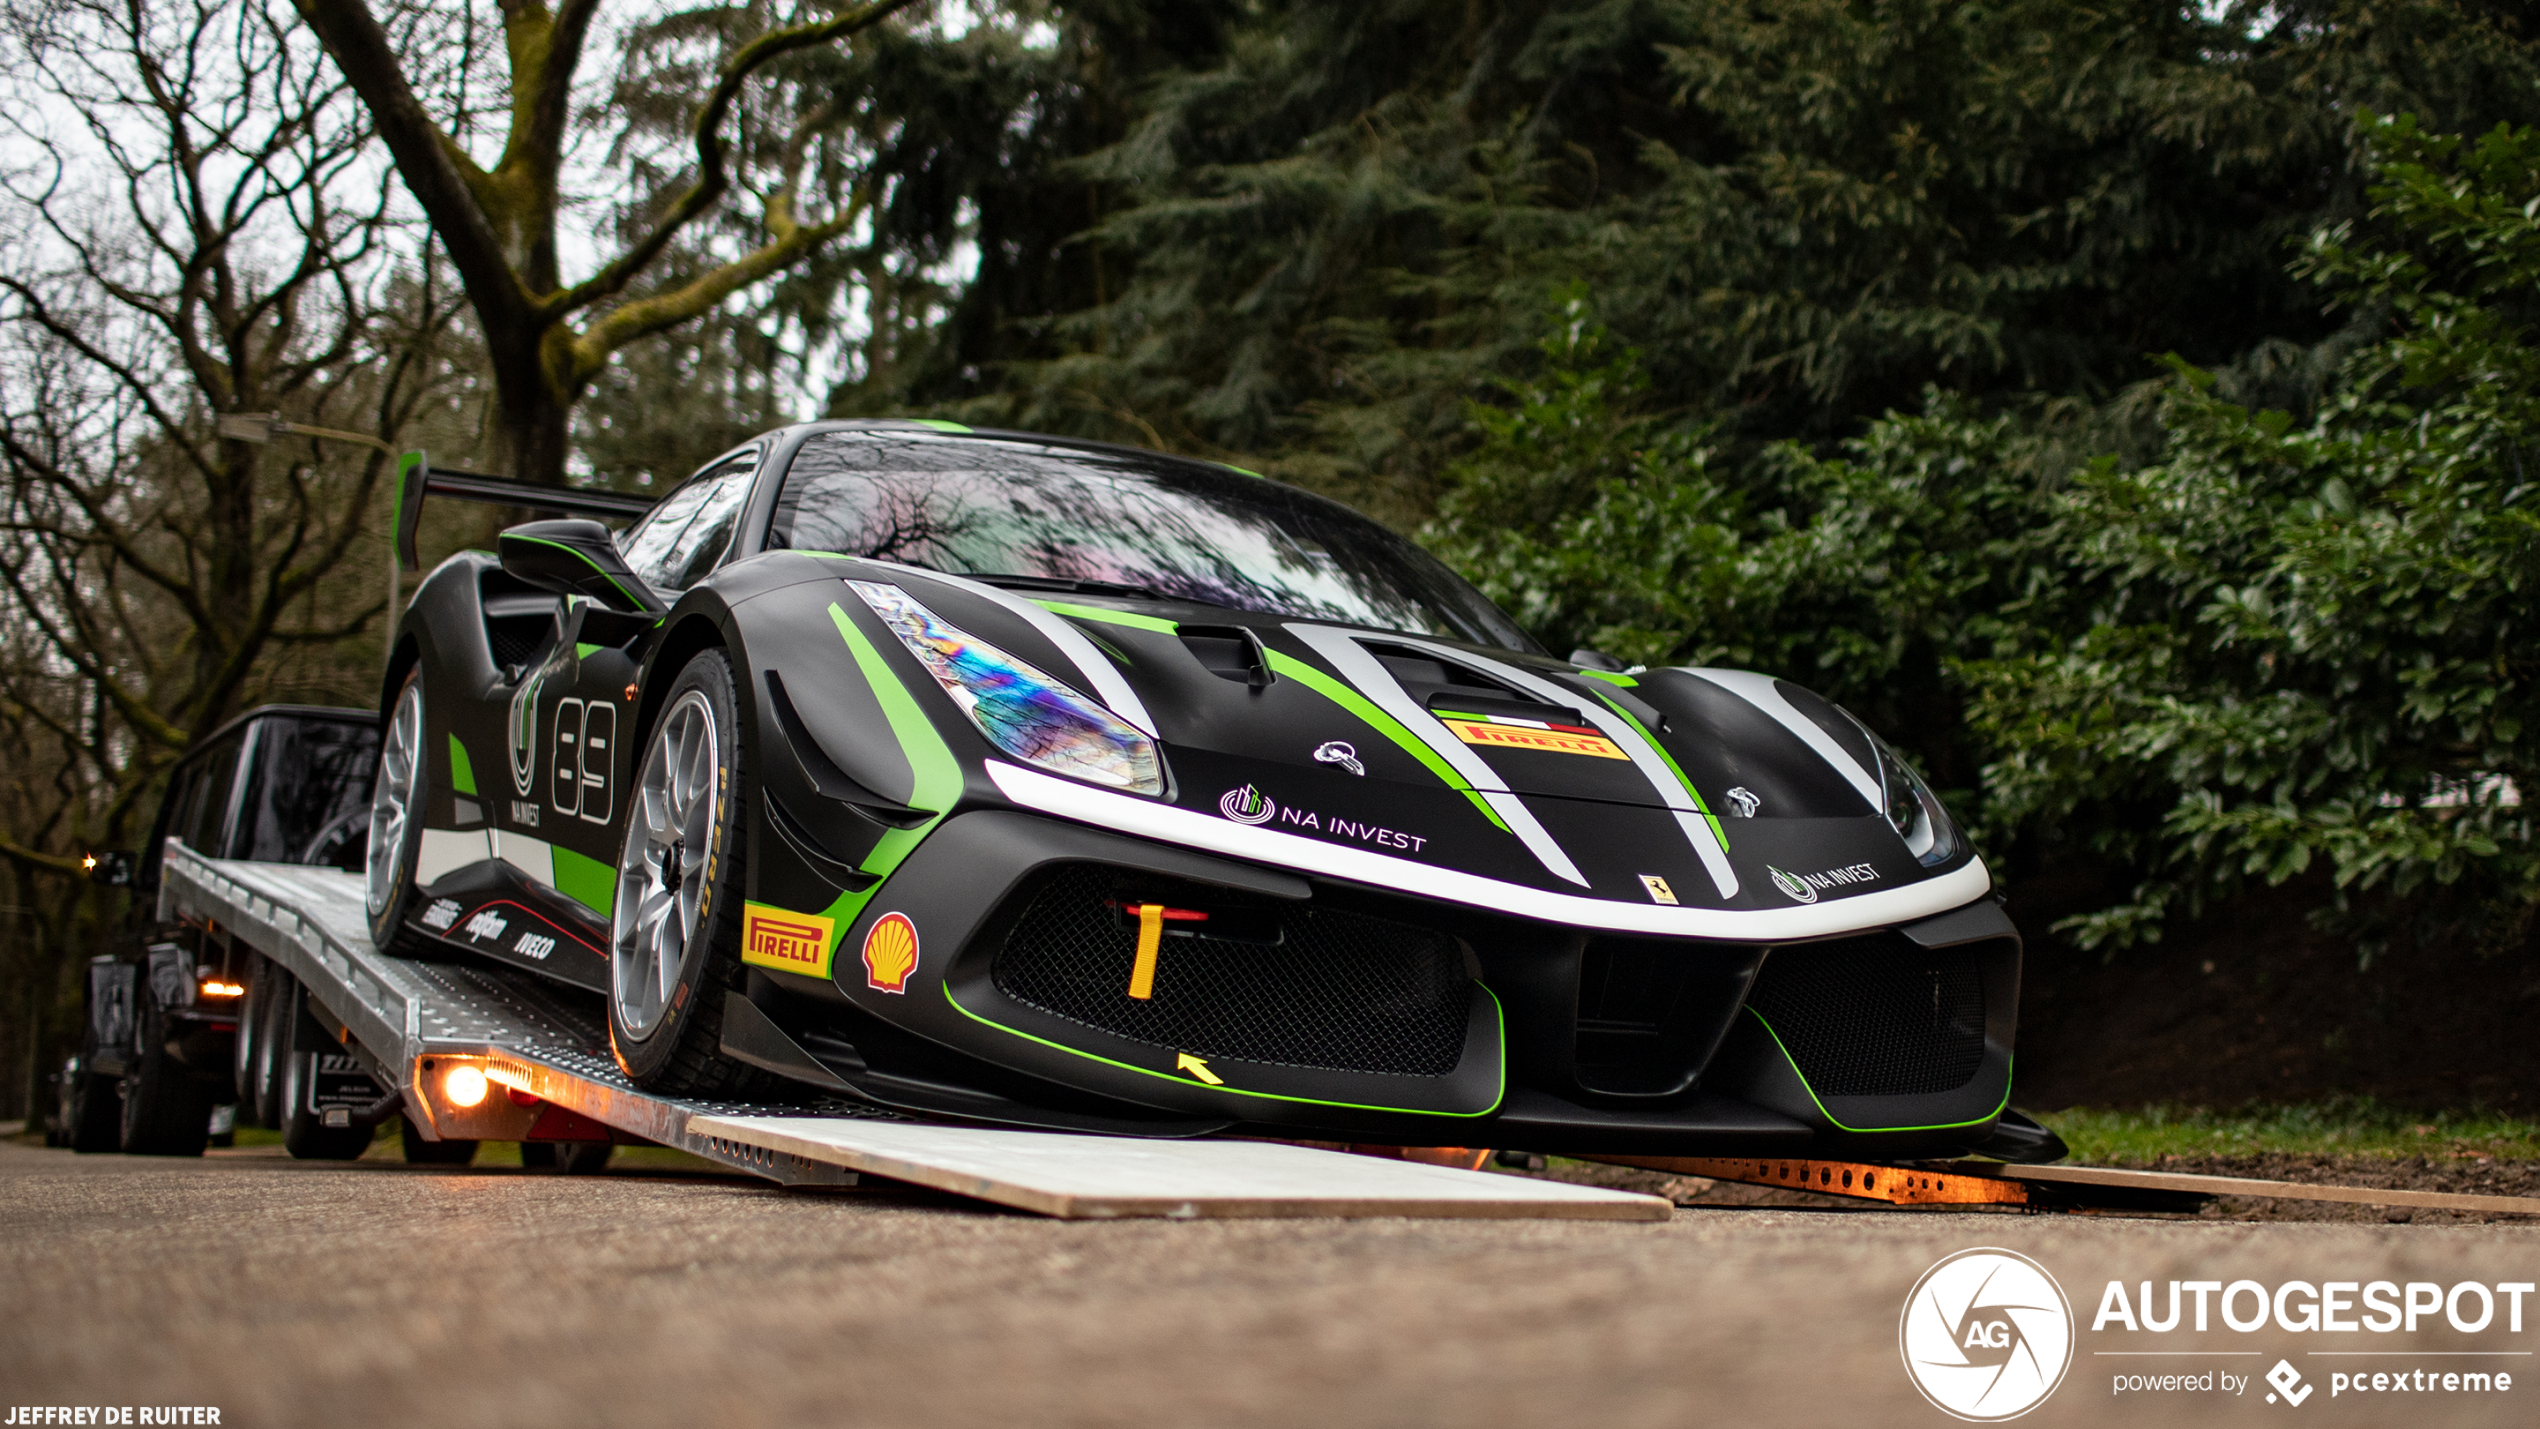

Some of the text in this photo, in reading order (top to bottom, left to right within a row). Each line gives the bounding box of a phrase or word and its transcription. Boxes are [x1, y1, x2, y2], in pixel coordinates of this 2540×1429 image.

[1464, 725, 1609, 754] PIRELLI
[552, 697, 616, 825] 89
[1281, 806, 1427, 852] NA INVEST
[1804, 863, 1881, 890] NA INVEST
[513, 932, 556, 960] IVECO
[749, 916, 823, 964] PIRELLI
